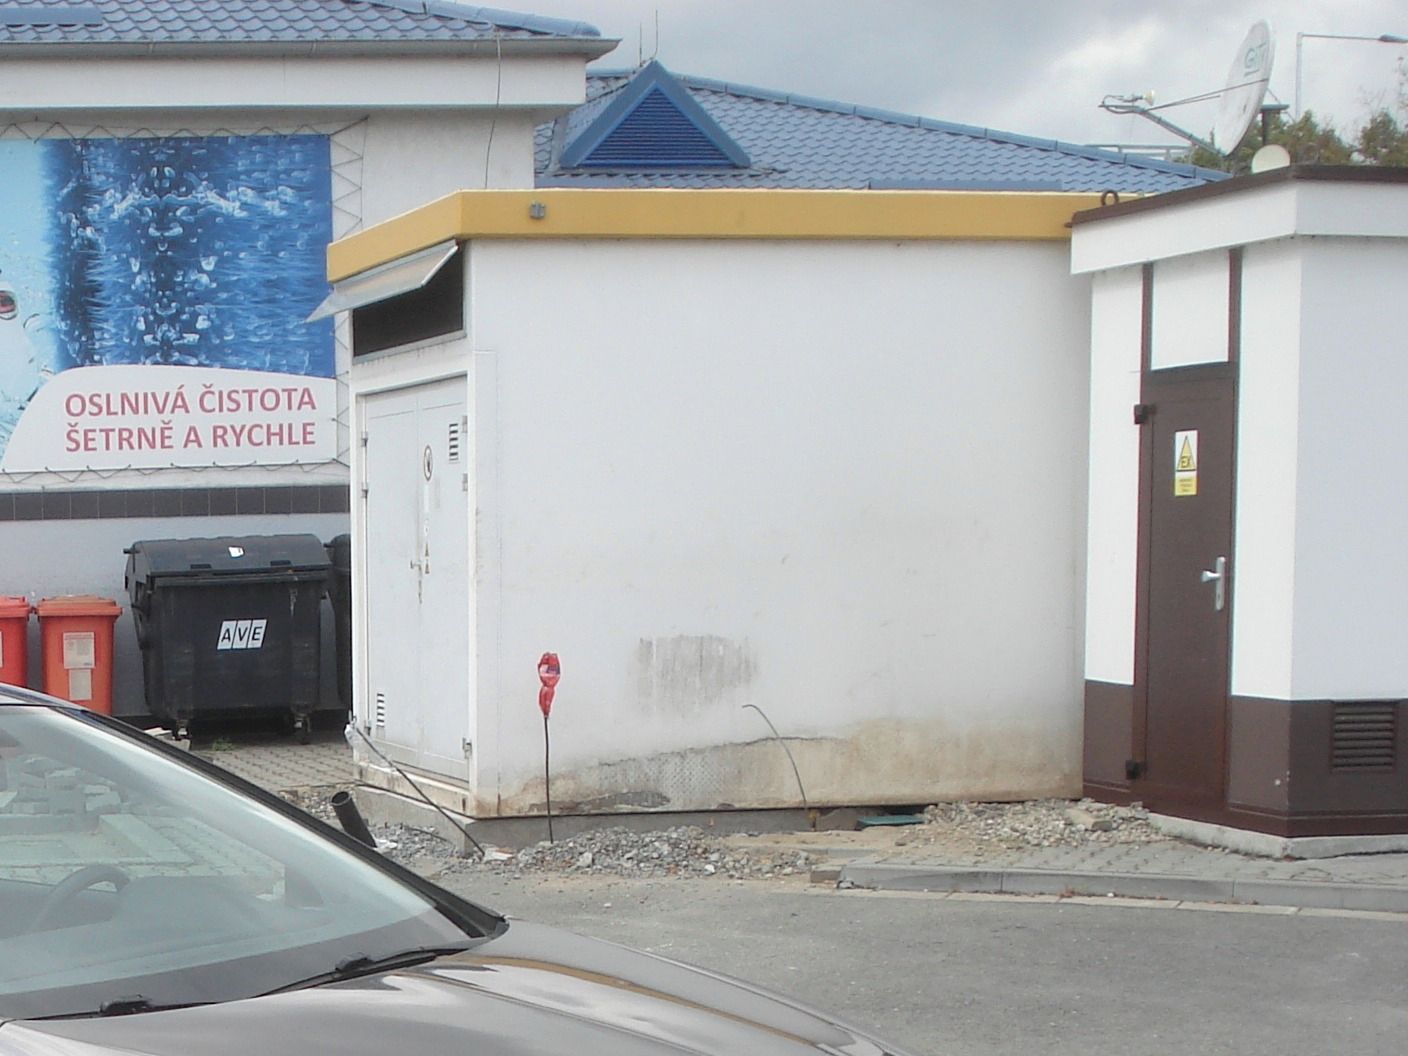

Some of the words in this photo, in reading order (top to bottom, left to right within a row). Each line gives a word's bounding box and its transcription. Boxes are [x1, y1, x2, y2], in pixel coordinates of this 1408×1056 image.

[65, 385, 190, 417] OSLNIVÁ
[199, 383, 317, 413] ČISTOTA
[66, 420, 174, 453] ŠETRNĚ
[183, 425, 203, 449] A
[212, 422, 316, 448] RYCHLE
[221, 626, 263, 643] AVE
